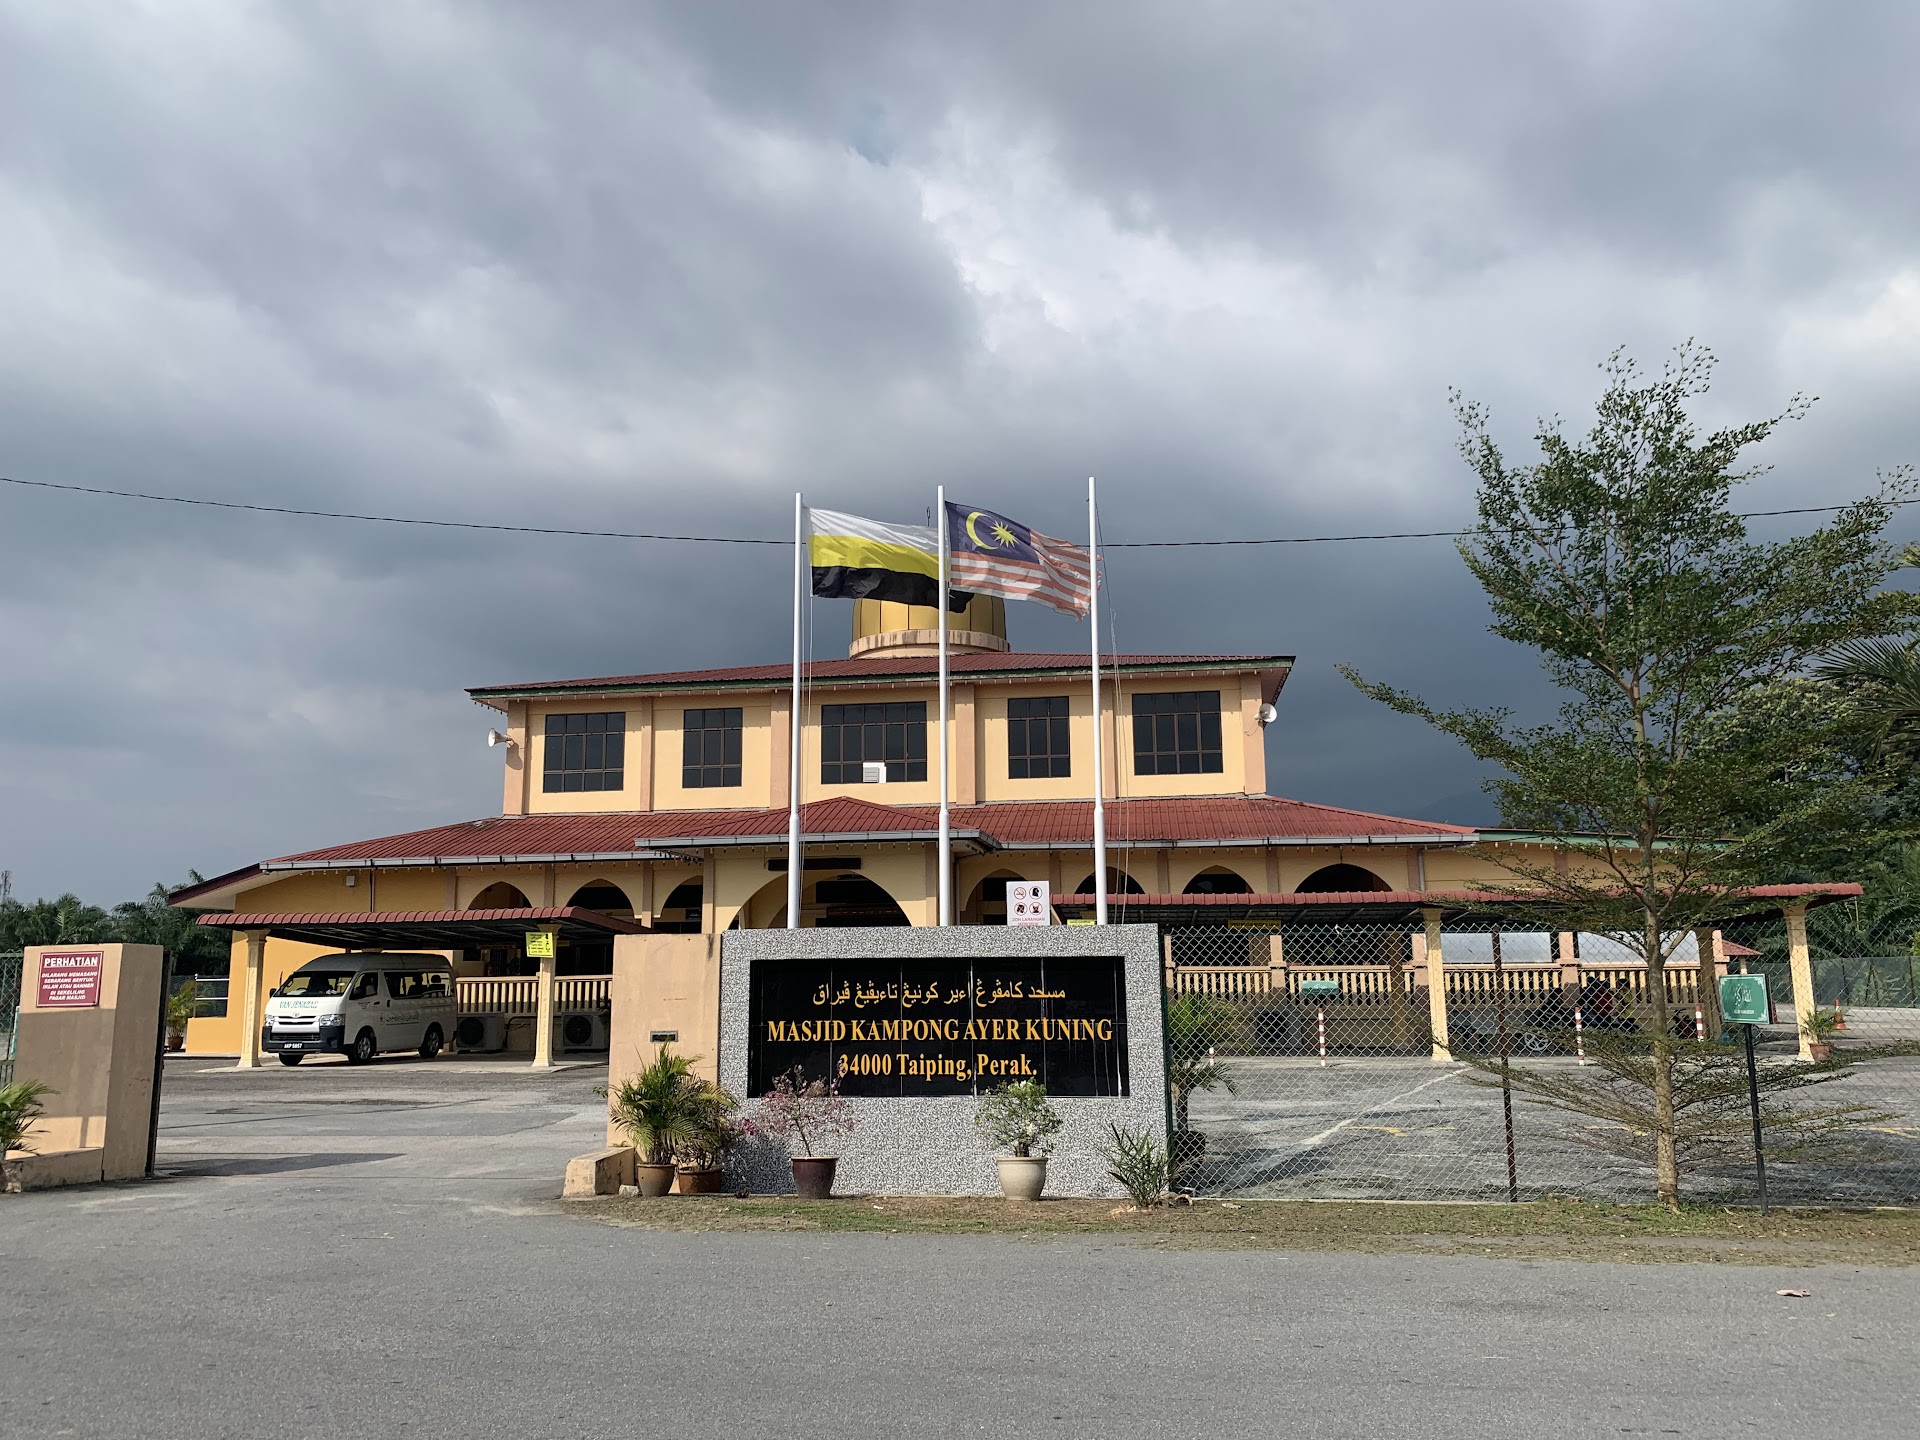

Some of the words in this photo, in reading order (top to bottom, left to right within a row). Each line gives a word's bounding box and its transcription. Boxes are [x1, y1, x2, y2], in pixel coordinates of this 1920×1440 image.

[44, 957, 98, 968] PERHATIAN
[767, 1020, 847, 1042] MASJID
[851, 1018, 960, 1041] KAMPONG
[963, 1018, 1021, 1041] AYER
[1024, 1017, 1113, 1041] KUNING
[838, 1053, 892, 1076] 34000
[896, 1053, 973, 1081] Taiping,
[976, 1053, 1038, 1076] Perak.
